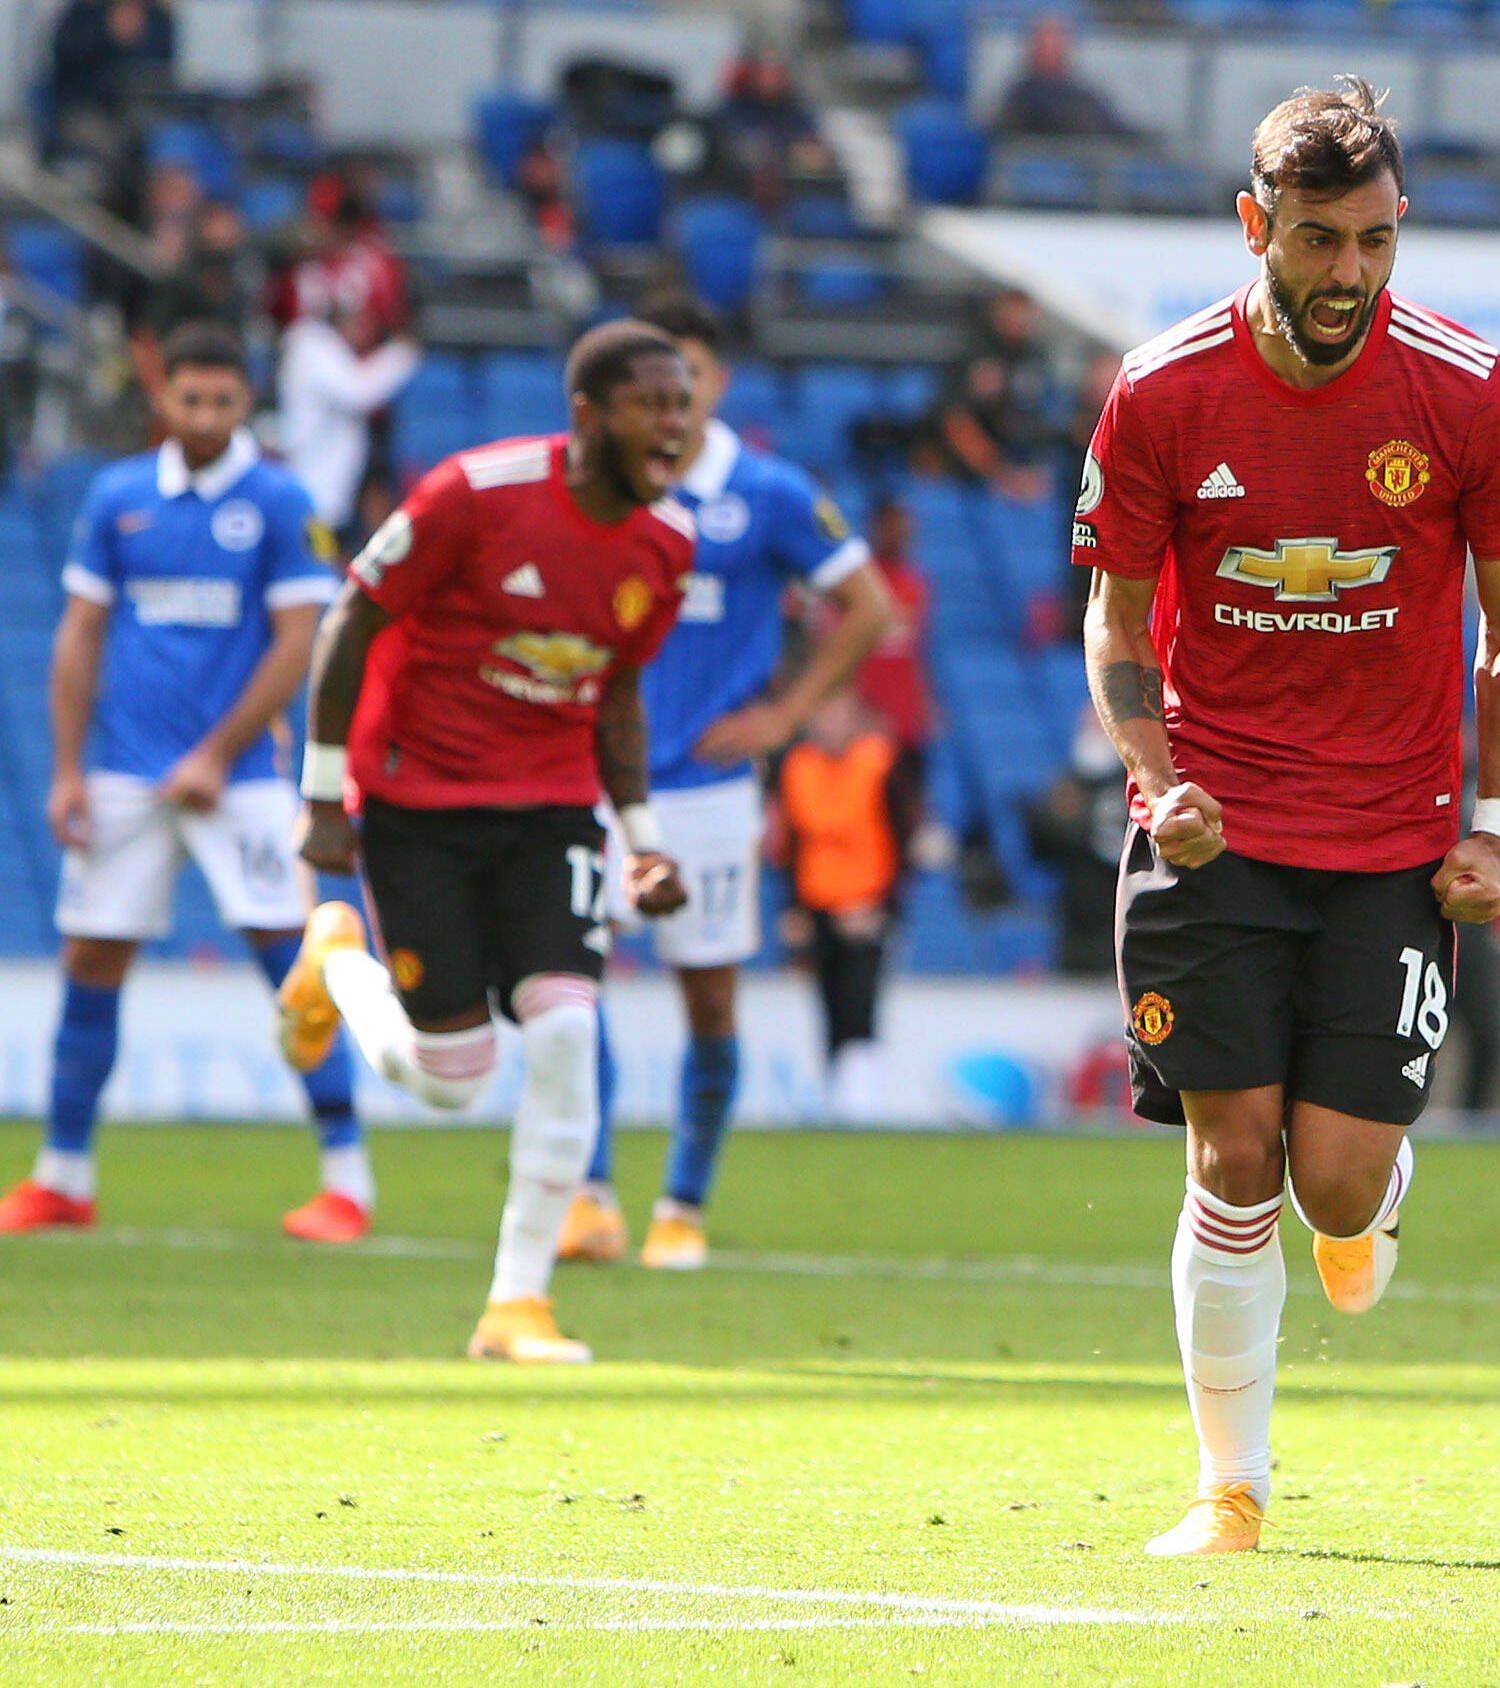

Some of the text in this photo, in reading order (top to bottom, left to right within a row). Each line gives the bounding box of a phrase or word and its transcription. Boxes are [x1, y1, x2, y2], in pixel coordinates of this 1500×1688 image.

[1372, 445, 1425, 467] MANCHESTER
[1197, 485, 1246, 499] adidas
[1379, 488, 1415, 502] UNITED
[1214, 602, 1400, 634] CHEVROLET
[1396, 946, 1450, 1051] 18
